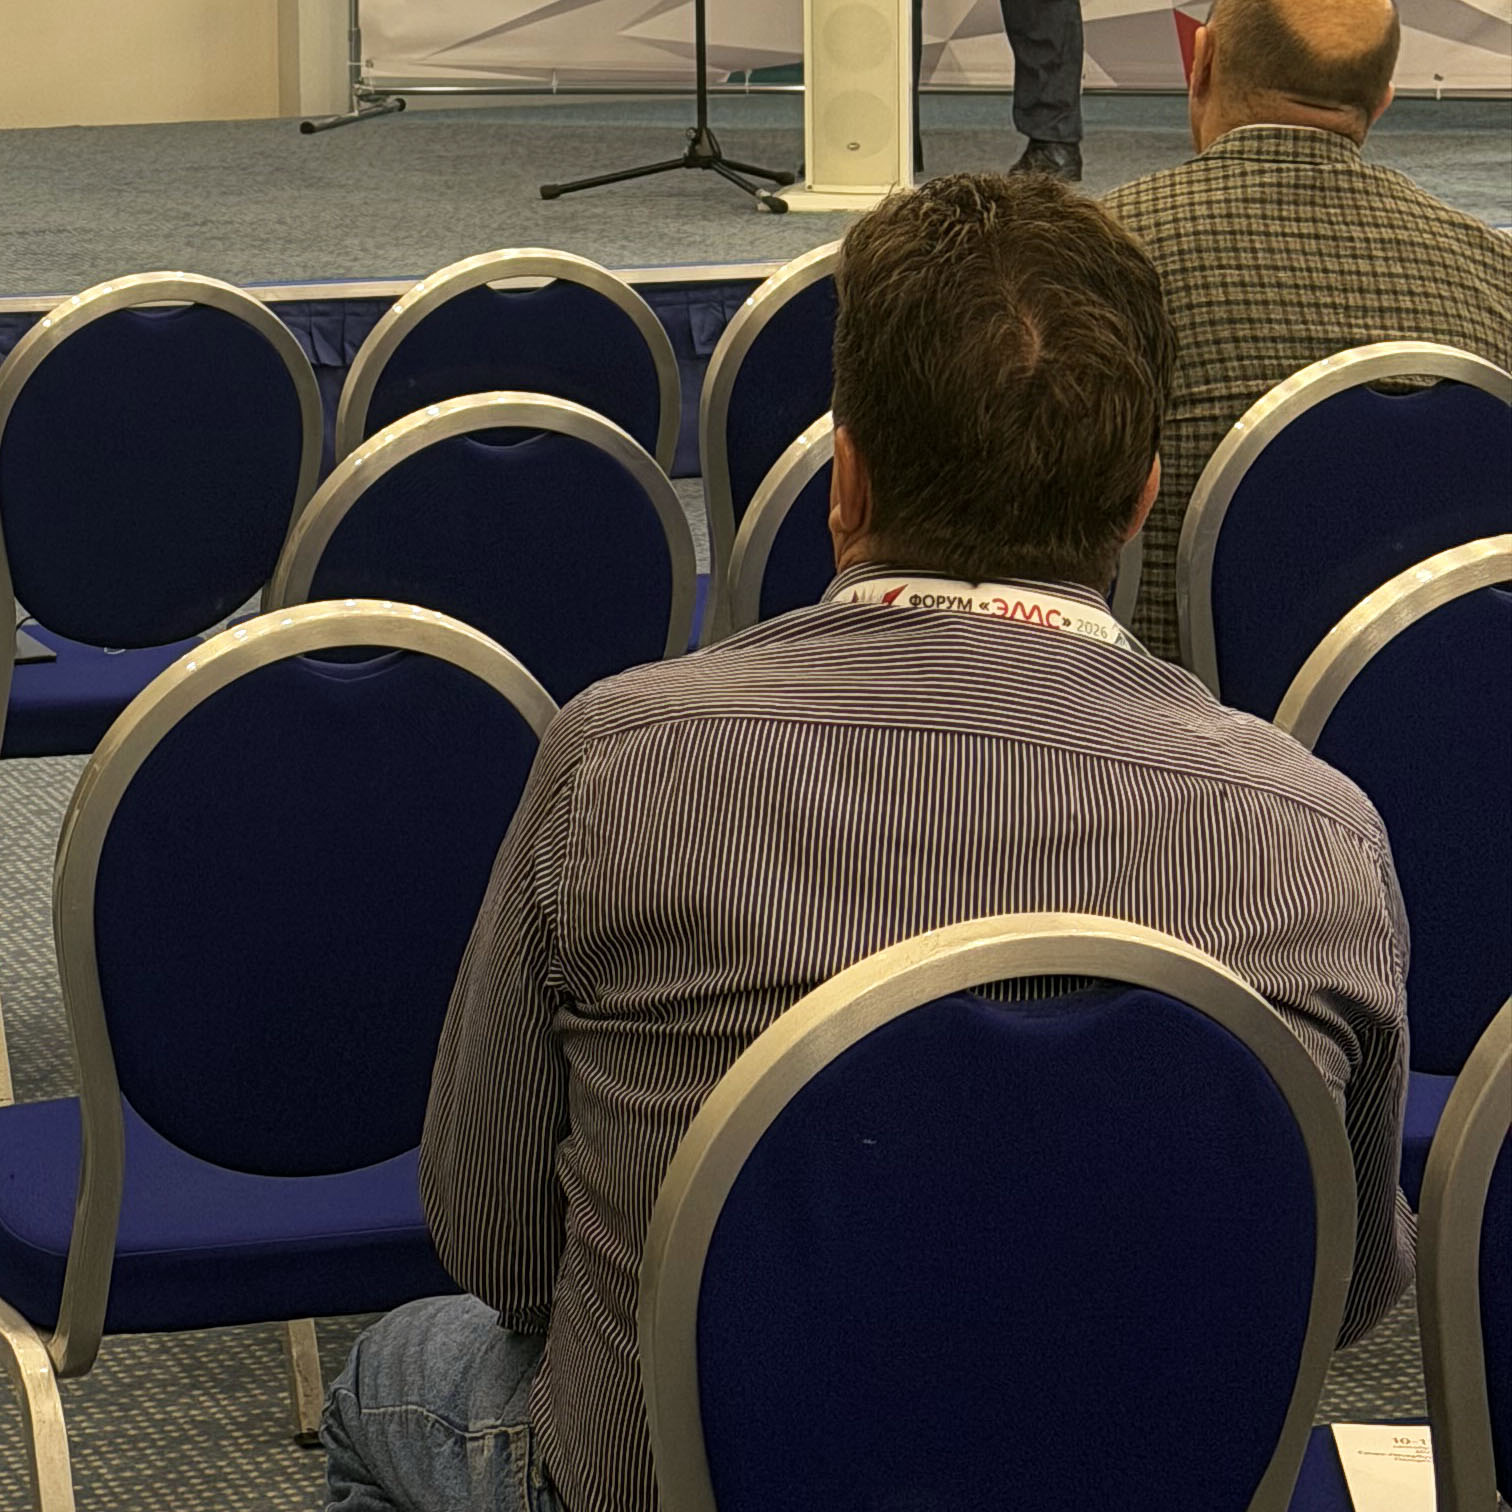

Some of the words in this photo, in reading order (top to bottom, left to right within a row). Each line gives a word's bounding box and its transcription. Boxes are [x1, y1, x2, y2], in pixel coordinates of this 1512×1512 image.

[909, 593, 973, 612] ФОРУМ
[979, 597, 1072, 629] «ЭМС»
[1076, 618, 1109, 639] 2026
